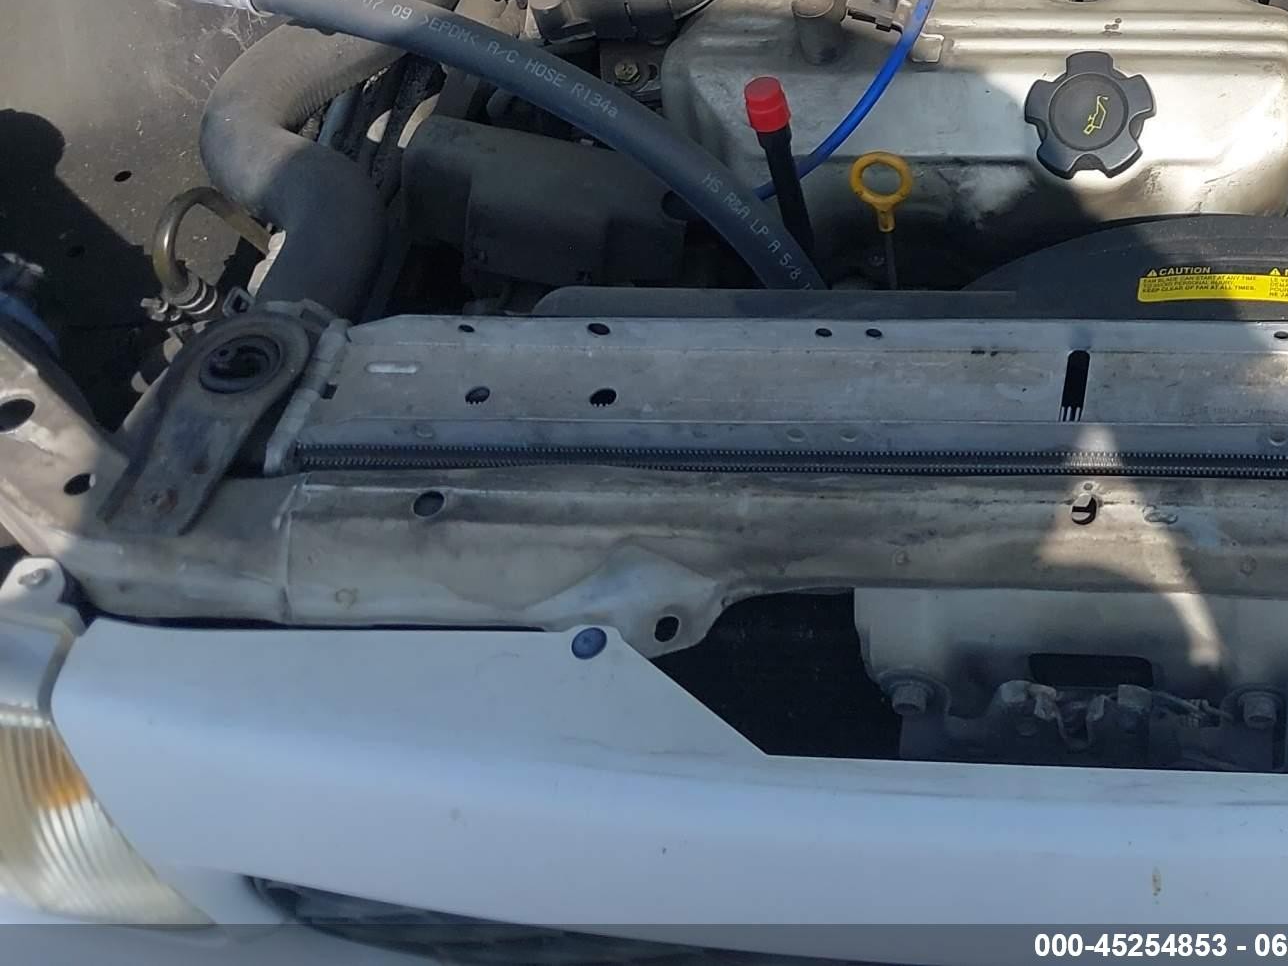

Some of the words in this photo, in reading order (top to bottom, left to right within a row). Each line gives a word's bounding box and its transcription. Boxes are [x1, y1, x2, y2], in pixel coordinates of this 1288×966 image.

[487, 40, 520, 64] A/C
[524, 58, 567, 88] HOSE
[571, 82, 619, 119] R134a
[1159, 267, 1211, 276] CAUTION
